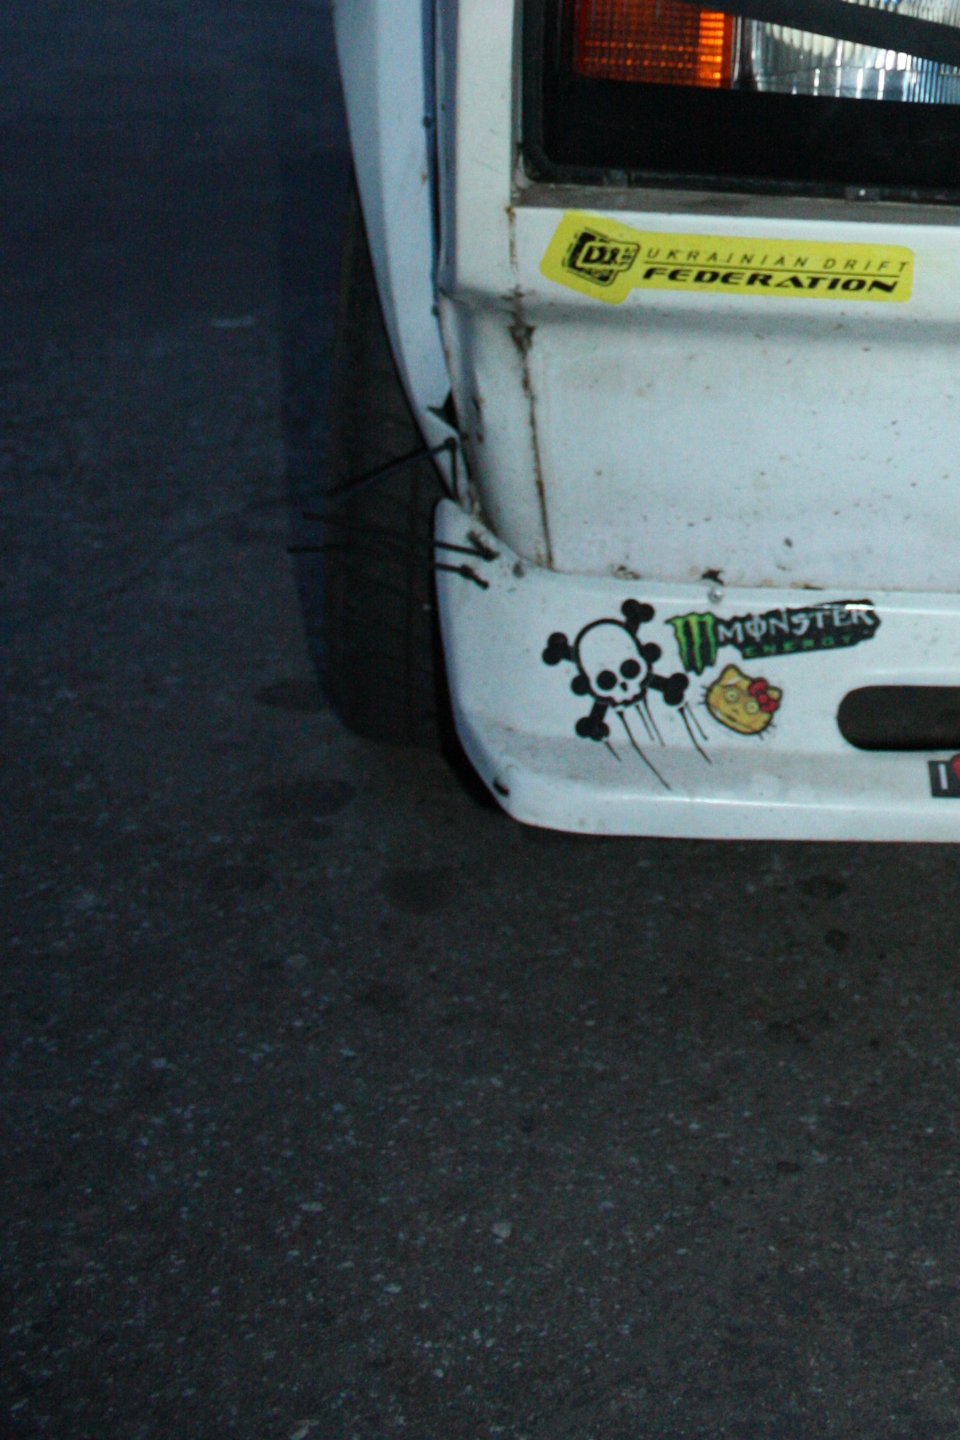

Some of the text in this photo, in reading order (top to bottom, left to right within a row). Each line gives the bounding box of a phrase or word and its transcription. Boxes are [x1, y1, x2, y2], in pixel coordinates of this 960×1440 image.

[647, 248, 910, 273] UKRAINIAN DRIFT
[643, 267, 898, 293] FEDERATION
[718, 608, 874, 643] MONSTER
[744, 633, 853, 657] ENERGY
[938, 763, 949, 790] I
